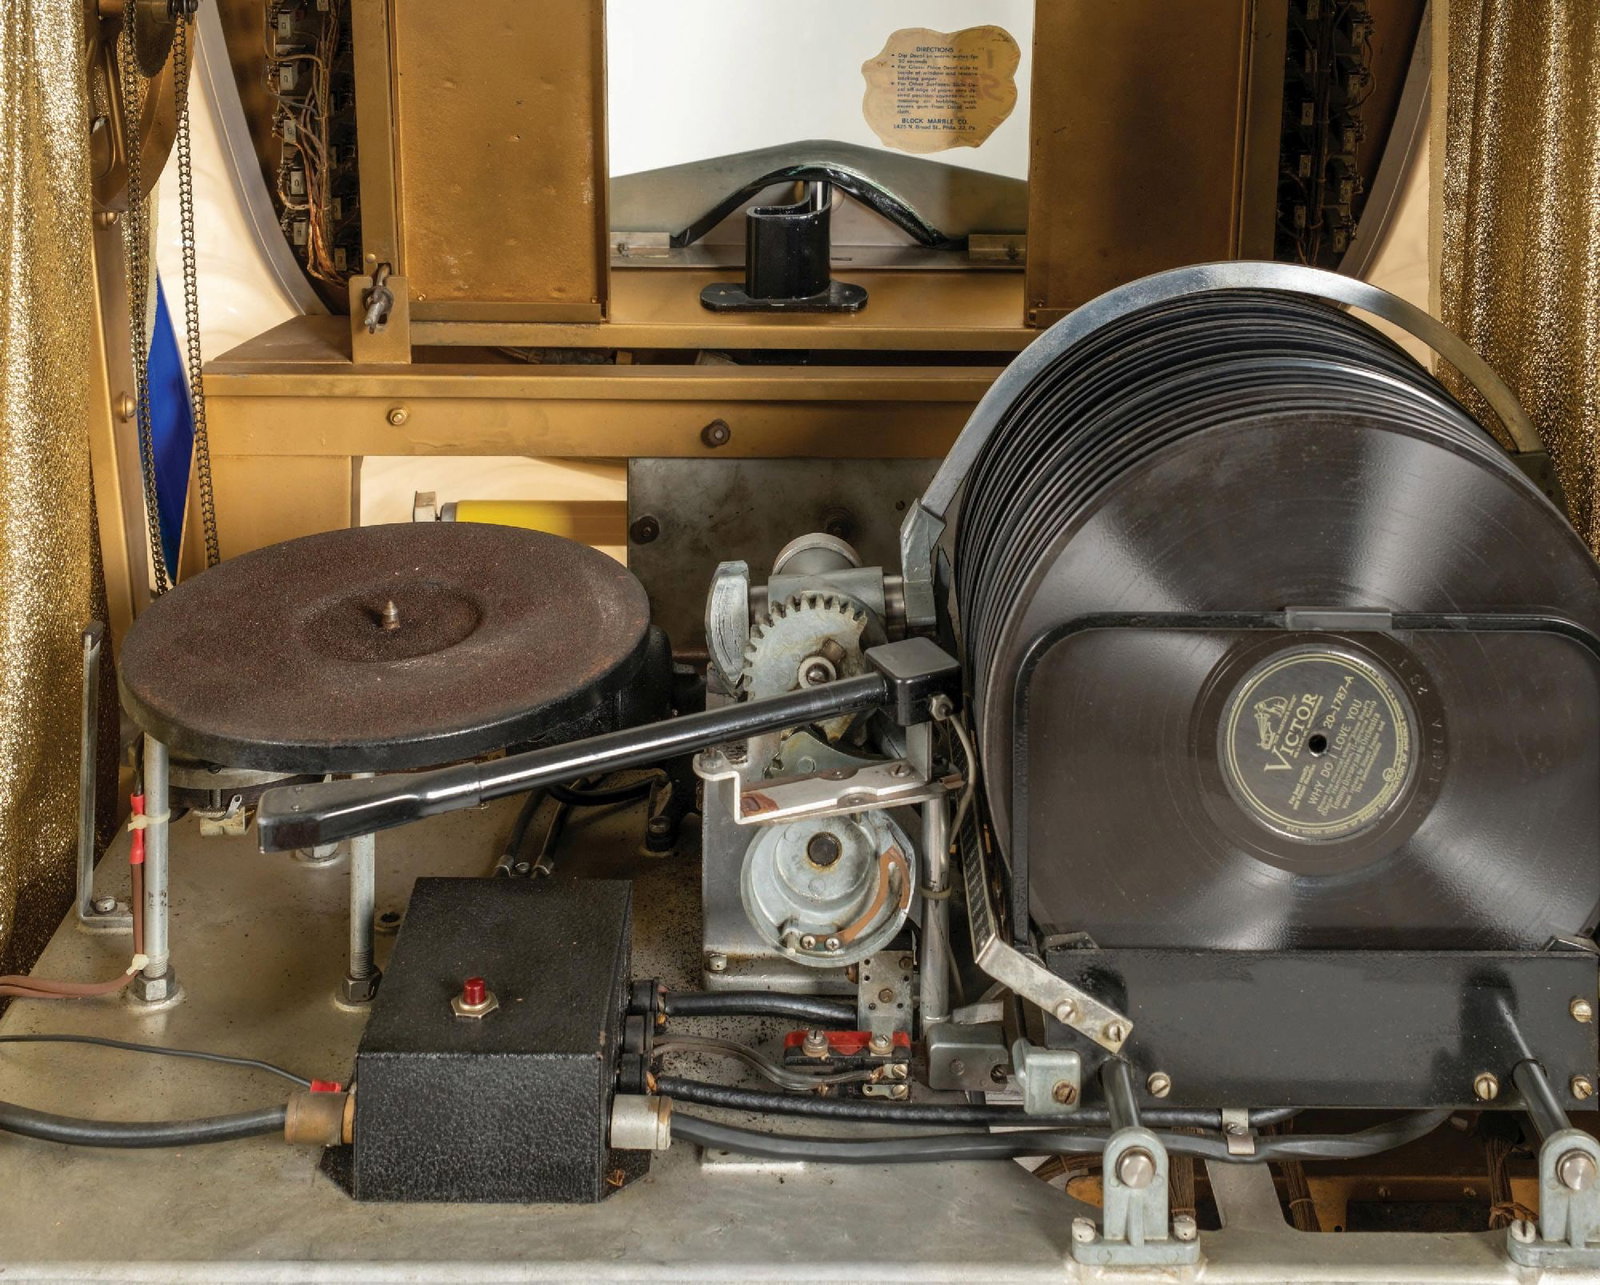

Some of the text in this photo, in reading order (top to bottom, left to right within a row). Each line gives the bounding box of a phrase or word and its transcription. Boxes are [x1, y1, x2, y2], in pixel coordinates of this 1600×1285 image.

[1264, 692, 1318, 772] VICTOR
[1323, 674, 1354, 729] 20-1787-A
[1359, 711, 1380, 746] Orchestra
[1307, 780, 1325, 806] WHY
[1319, 761, 1334, 778] DO
[1331, 722, 1352, 751] LOVE
[1345, 698, 1363, 722] YOU
